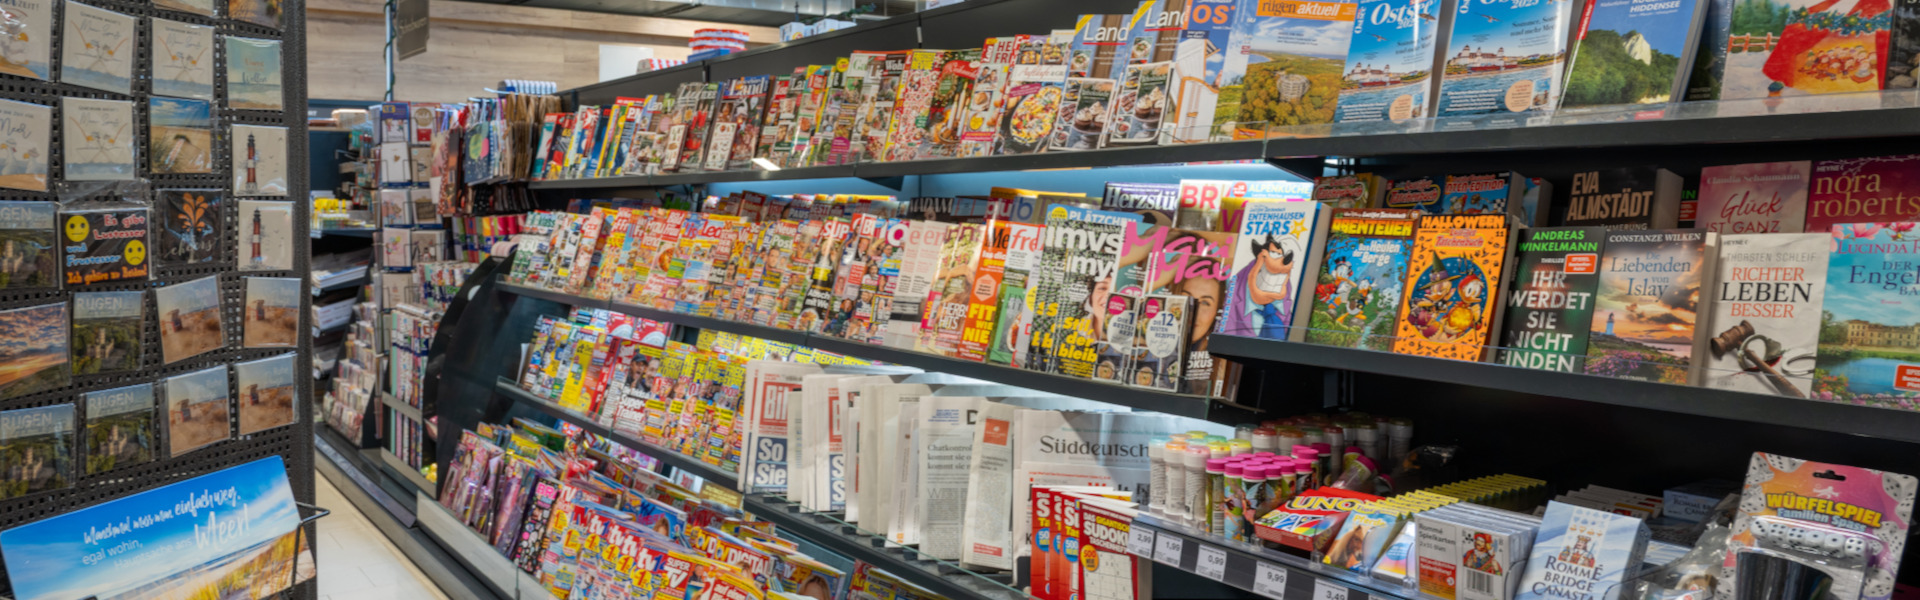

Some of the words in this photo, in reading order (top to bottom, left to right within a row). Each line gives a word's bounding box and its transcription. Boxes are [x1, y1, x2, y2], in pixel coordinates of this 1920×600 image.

[1262, 0, 1296, 16] rügen
[1297, 4, 1341, 16] aktuell
[1630, 1, 1681, 13] HIDDENSEE
[1083, 22, 1130, 42] Land
[1571, 171, 1599, 195] EVA
[1815, 174, 1881, 195] nora
[1566, 188, 1654, 221] ALMSTÄDT
[1720, 190, 1783, 223] Glück
[1812, 191, 1920, 218] roberts
[1248, 212, 1306, 221] ENTENHAUSEN
[1420, 215, 1505, 229] HALLOWEEN
[1245, 221, 1290, 235] STARS
[1706, 221, 1726, 233] IST
[1732, 220, 1780, 233] GANZ
[1532, 231, 1585, 241] ANDREAS
[1609, 234, 1663, 243] CONSTANZE
[1663, 233, 1701, 241] WILKEN
[66, 243, 88, 252] und
[1370, 242, 1400, 253] Heulen
[1519, 242, 1598, 252] WINKELMANN
[1838, 241, 1907, 254] LUCINDA
[66, 255, 121, 266] Frustesser
[1362, 253, 1390, 267] Berge
[1646, 251, 1660, 260] Die
[1726, 252, 1772, 262] THORSTEN
[1775, 252, 1816, 262] SCHLEIF
[1610, 256, 1691, 273] Liebenden
[1882, 261, 1912, 271] DER
[1532, 270, 1567, 288] IHR
[1651, 276, 1669, 284] von
[1732, 267, 1804, 282] RICHTER
[1626, 277, 1669, 303] Islay
[1721, 282, 1813, 303] LEBEN
[1508, 291, 1591, 310] WERDET
[968, 303, 996, 321] FIT
[1730, 303, 1795, 318] BESSER
[975, 321, 994, 330] WIE
[1161, 313, 1174, 326] 12
[1527, 311, 1557, 329] SIE
[963, 327, 990, 344] NIE
[1508, 330, 1573, 352] NICHT
[758, 438, 784, 461] So
[756, 463, 786, 485] Sie
[1291, 497, 1358, 511] UNO
[1766, 492, 1882, 527] WÜRFELSPIEL
[1777, 508, 1829, 523] Familien
[1831, 517, 1867, 532] Spass
[1418, 522, 1443, 535] Rommé
[1138, 534, 1152, 544] 2,99
[1417, 531, 1457, 546] Spielkarten
[82, 549, 106, 565] egal
[107, 539, 143, 556] wohin,
[1084, 549, 1096, 558] 500
[1165, 541, 1181, 552] 1,99
[667, 557, 690, 571] SUPER
[1208, 555, 1224, 566] 0,99
[1545, 556, 1604, 581] ROMMÉ
[663, 565, 688, 588] TV
[1267, 572, 1285, 583] 9,99
[1544, 571, 1594, 592] BRIDGE
